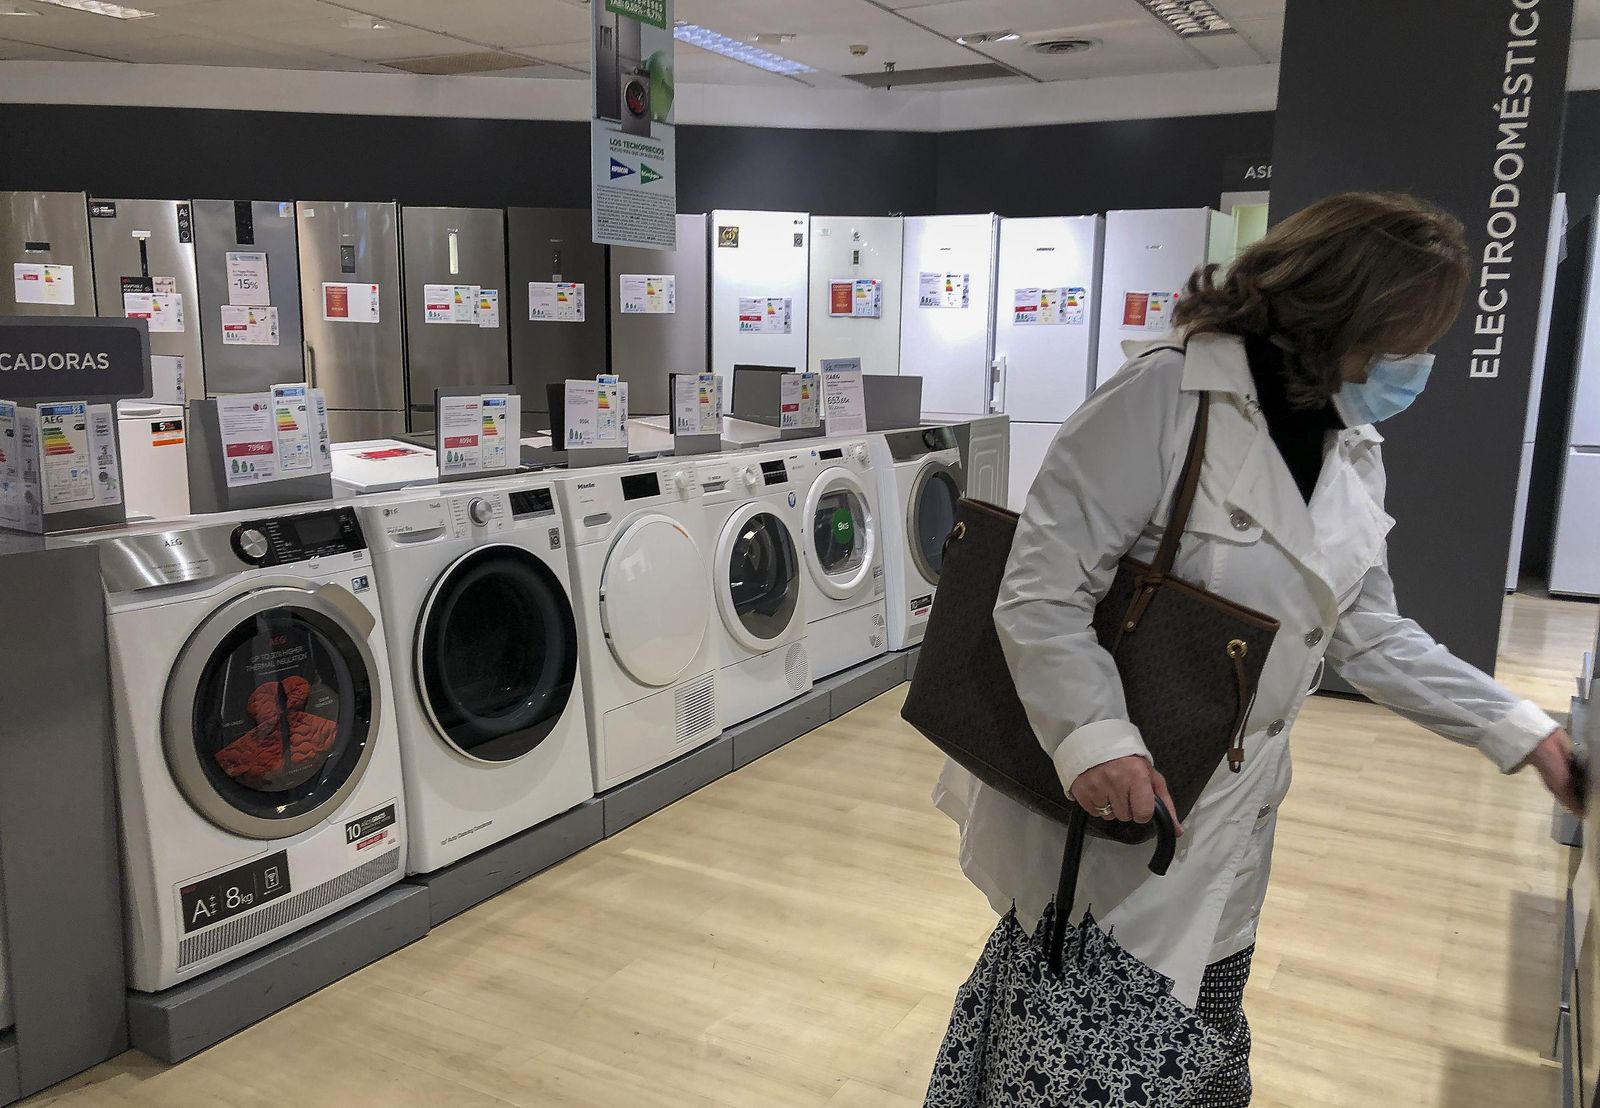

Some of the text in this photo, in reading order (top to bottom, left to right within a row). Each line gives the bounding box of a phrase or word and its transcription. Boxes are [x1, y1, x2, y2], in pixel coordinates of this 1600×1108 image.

[609, 138, 621, 147] LOS
[1470, 0, 1541, 379] ELECTRODOMÉSTIC
[43, 415, 64, 425] AEG
[164, 538, 183, 548] AEG
[346, 822, 362, 841] 10
